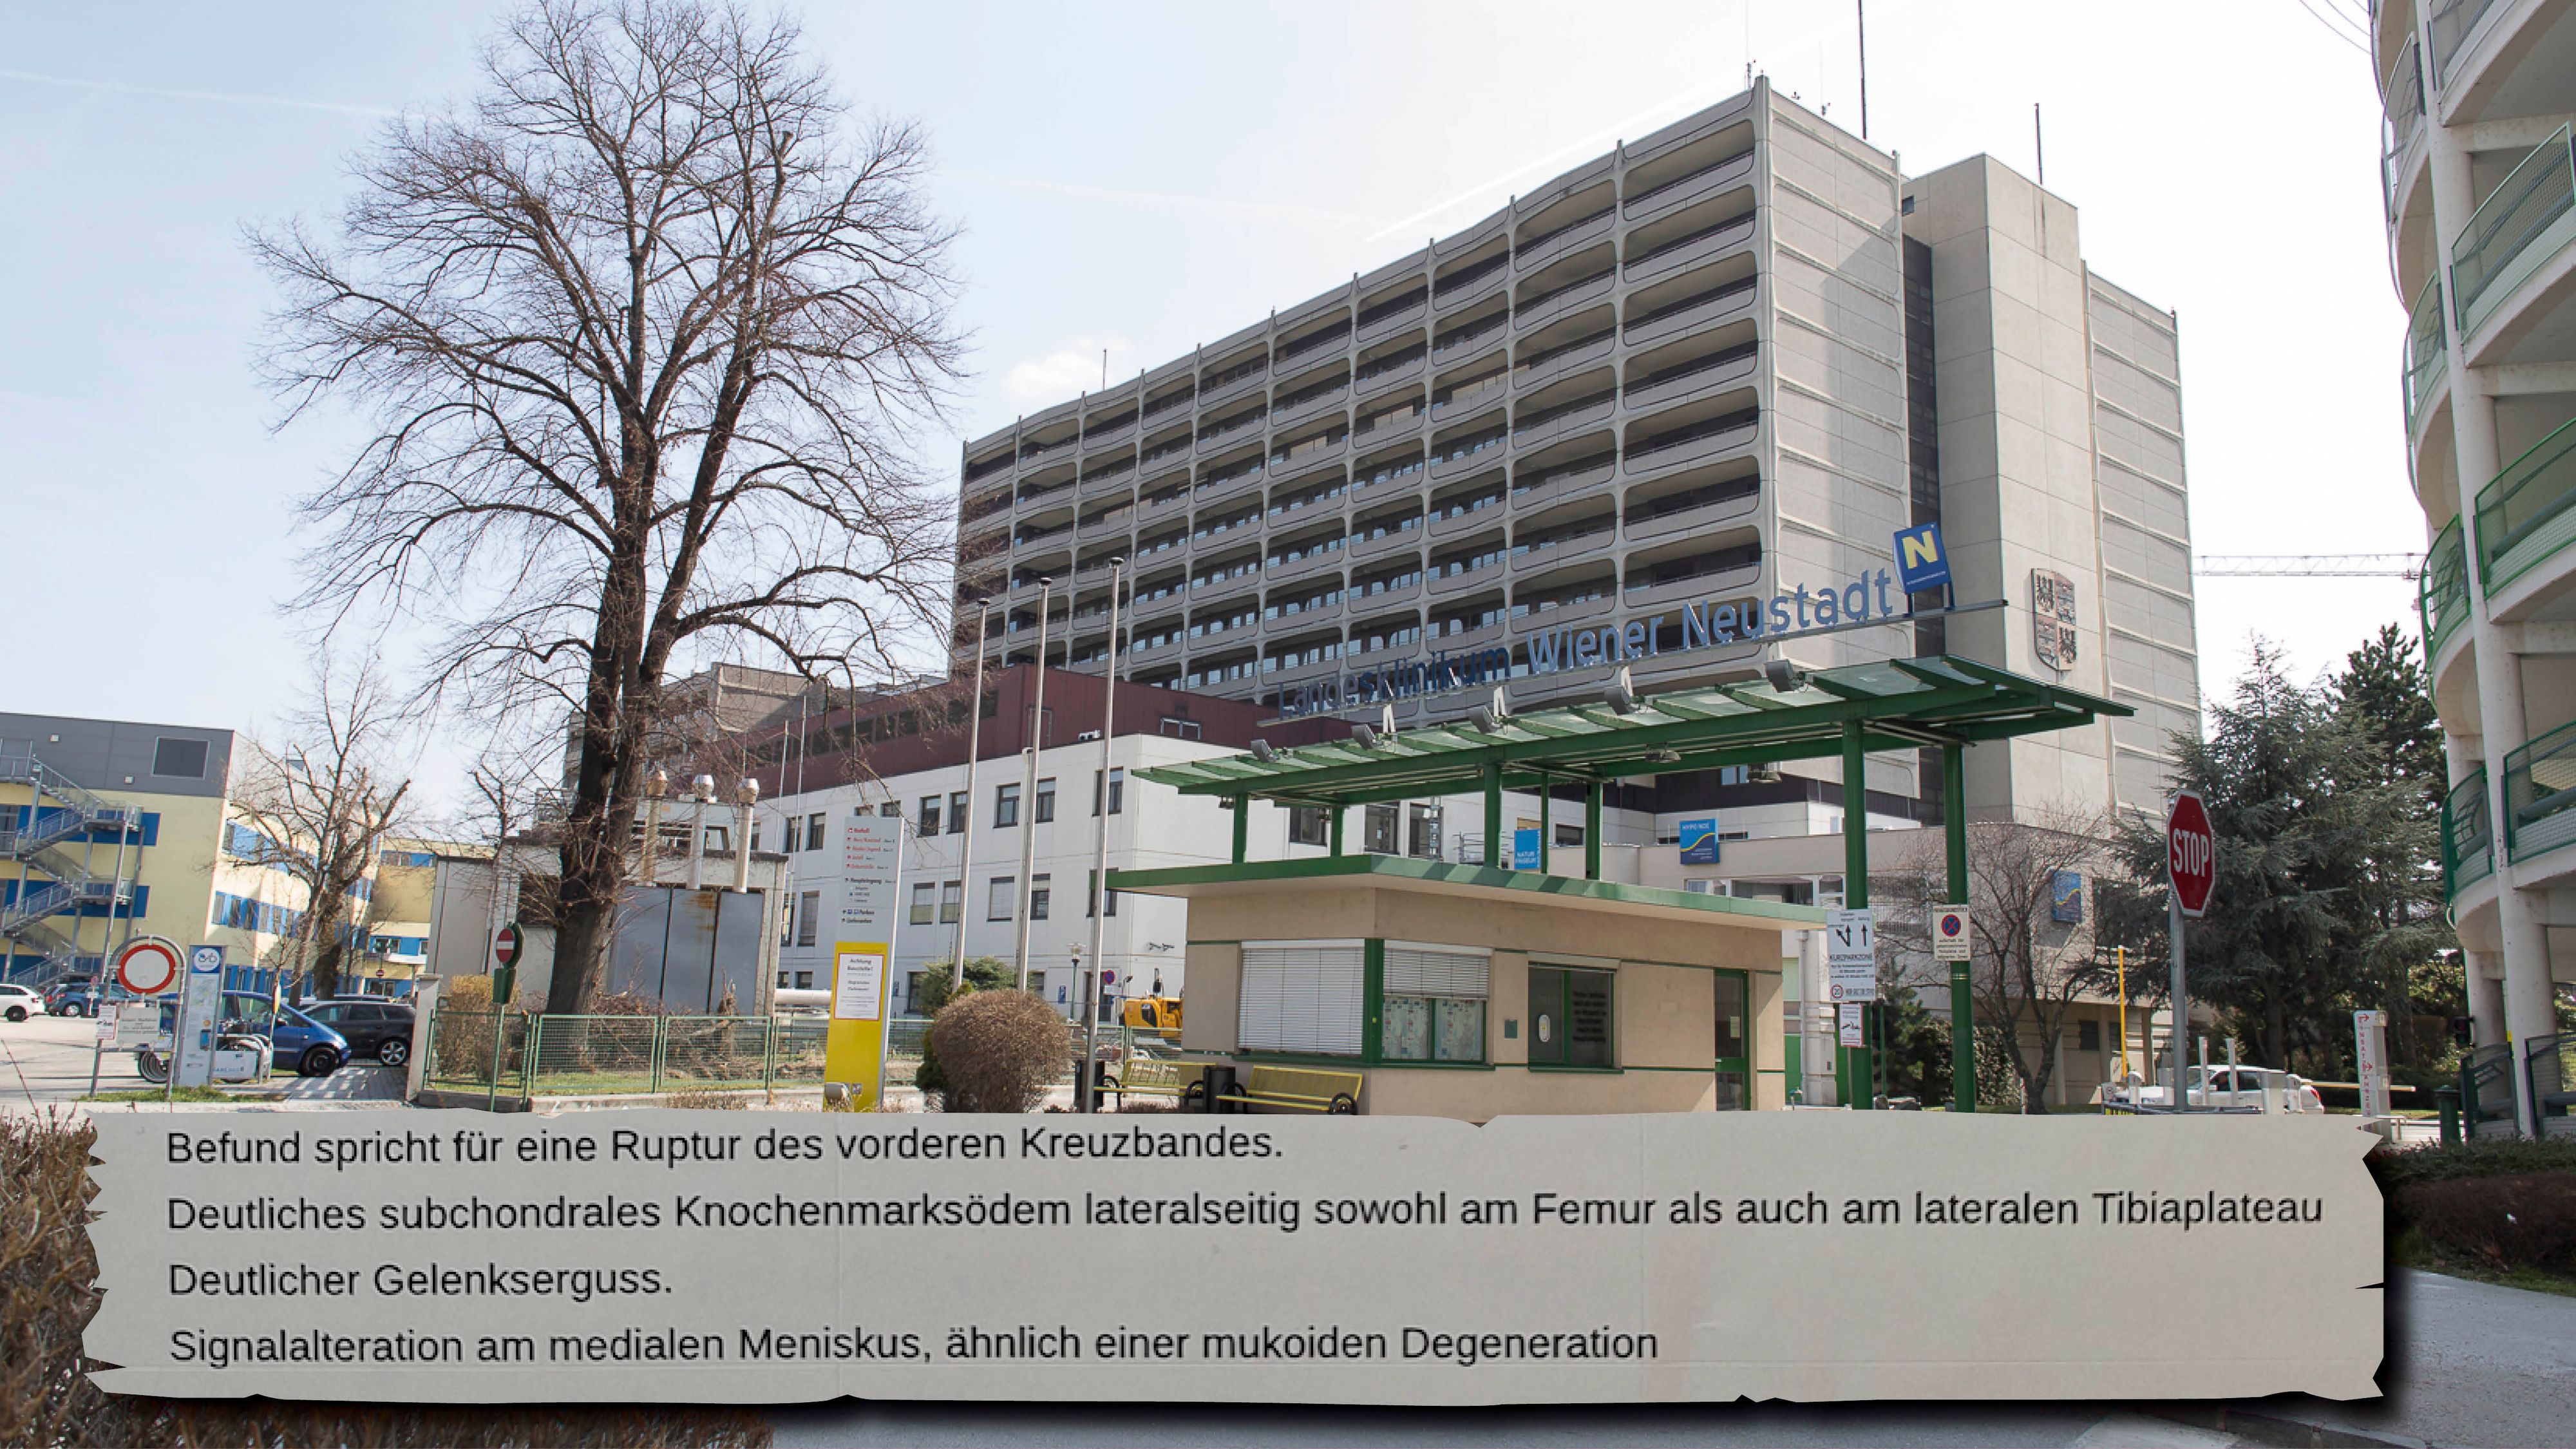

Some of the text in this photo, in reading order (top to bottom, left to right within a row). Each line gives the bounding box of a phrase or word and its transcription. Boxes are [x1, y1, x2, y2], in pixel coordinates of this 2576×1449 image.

[1901, 530, 1939, 569] N
[1278, 567, 1893, 720] Landesklinikum Wiener Neustadt
[2172, 828, 2210, 877] STOP
